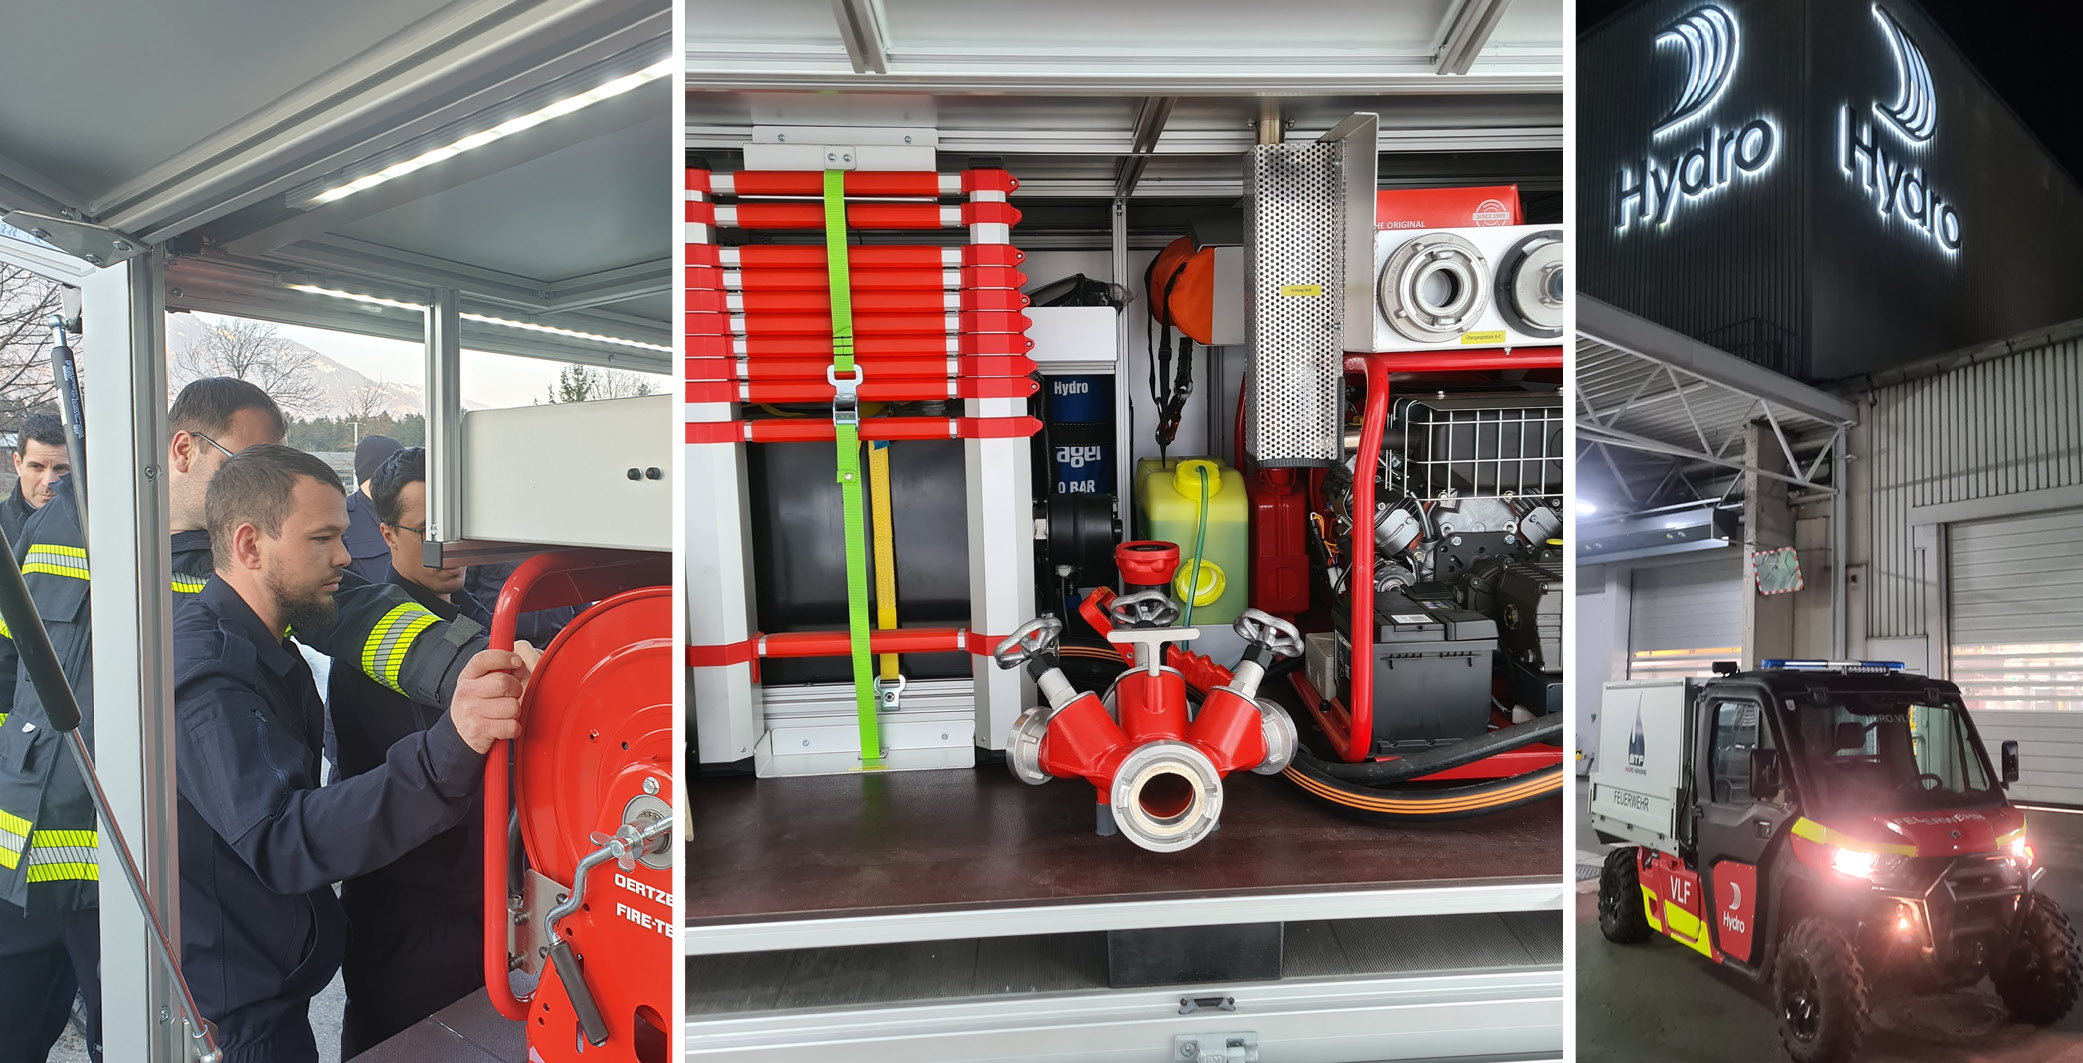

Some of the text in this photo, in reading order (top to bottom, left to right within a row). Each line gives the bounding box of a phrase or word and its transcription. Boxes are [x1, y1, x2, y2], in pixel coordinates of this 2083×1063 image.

[1613, 117, 1777, 229] Hydro
[1842, 104, 1962, 253] Hydro
[1387, 220, 1426, 229] ORIGINAL
[1053, 380, 1089, 397] Hydro
[1070, 480, 1096, 494] BAR
[1613, 790, 1650, 812] FEUERWEHR
[1670, 876, 1690, 904] VLF
[1723, 911, 1745, 933] Hydro
